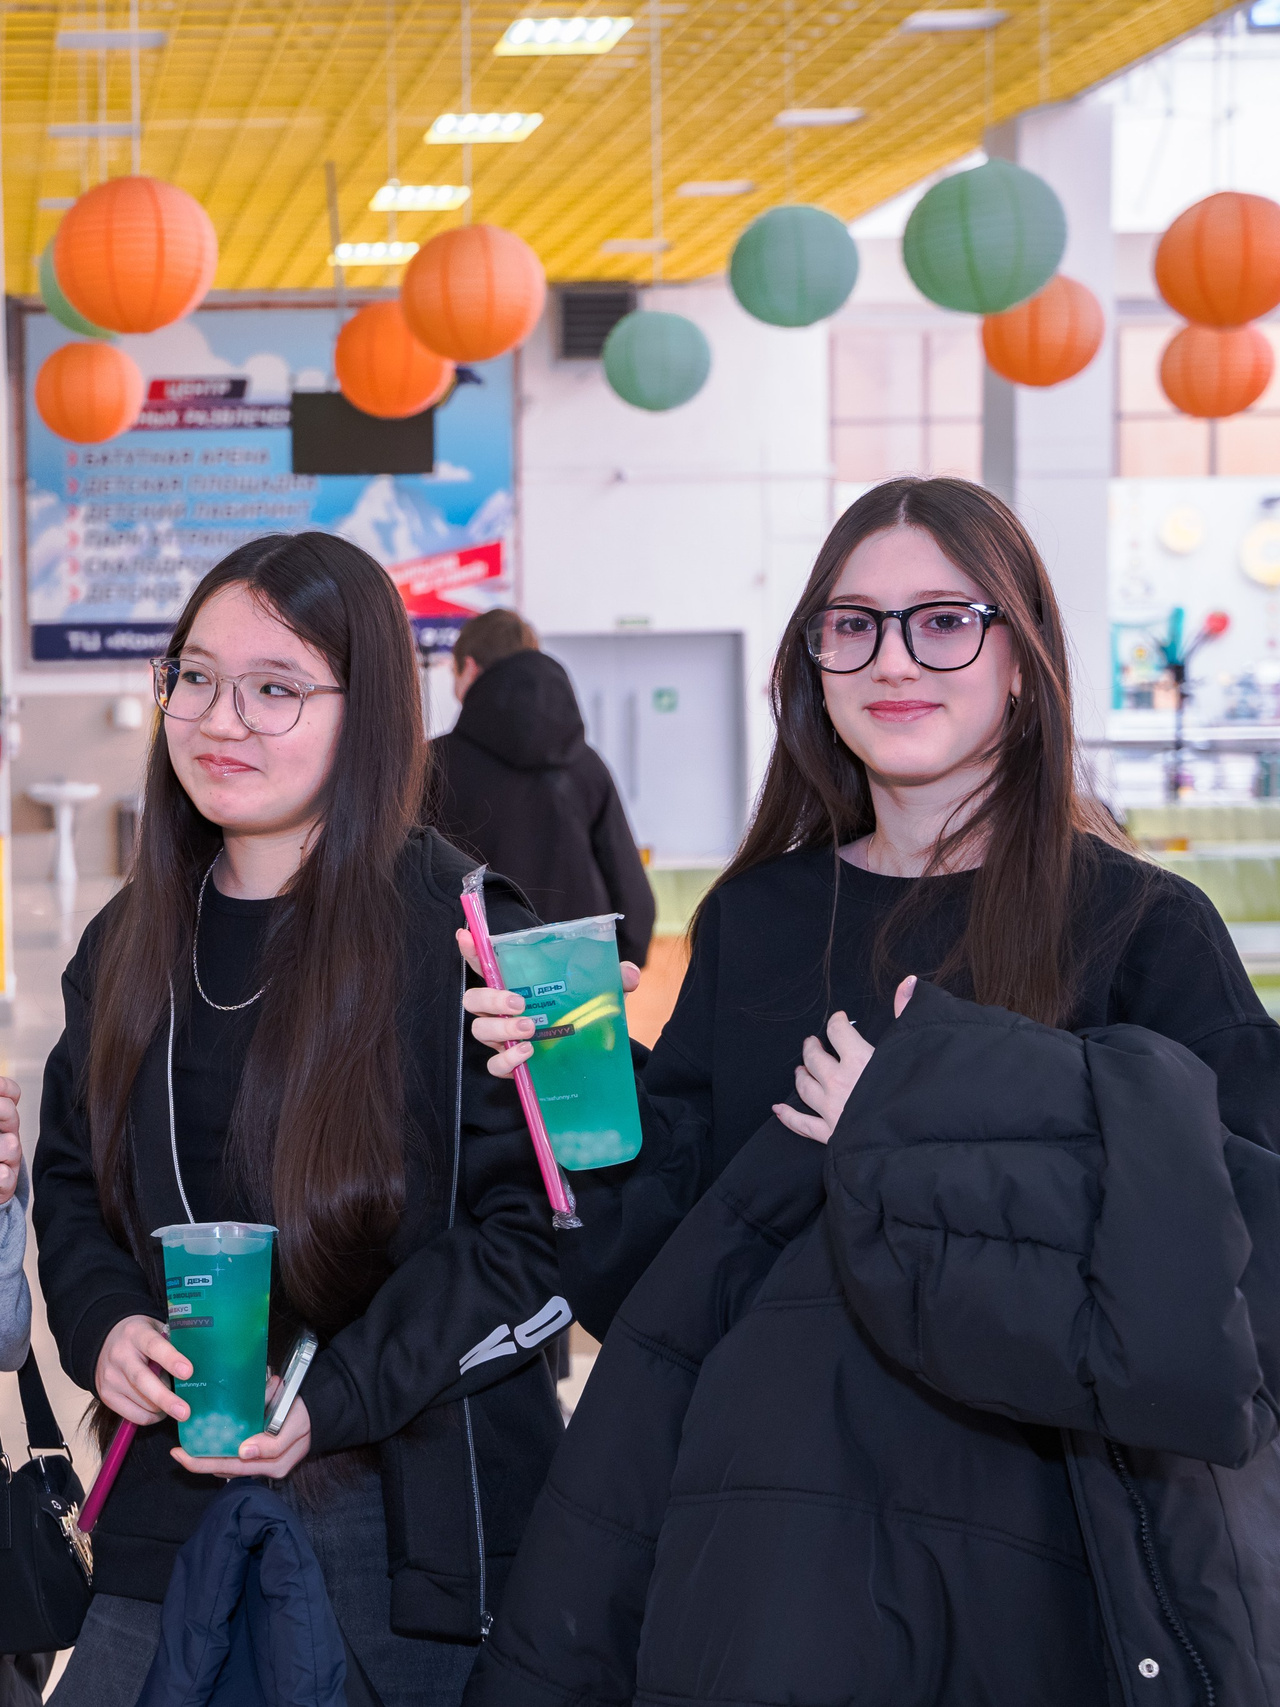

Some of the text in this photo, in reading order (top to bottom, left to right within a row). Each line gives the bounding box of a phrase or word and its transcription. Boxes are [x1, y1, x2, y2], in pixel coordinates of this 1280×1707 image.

[84, 447, 269, 465] БАТУТНАЯ АРЕНА
[84, 476, 184, 497] ДЕТСКАЯ
[85, 502, 187, 522] ДЕТСКИЙ
[537, 984, 563, 994] ДЕНЬ
[535, 1027, 570, 1038] UNNYYY
[186, 1277, 210, 1285] ДЕНЬ
